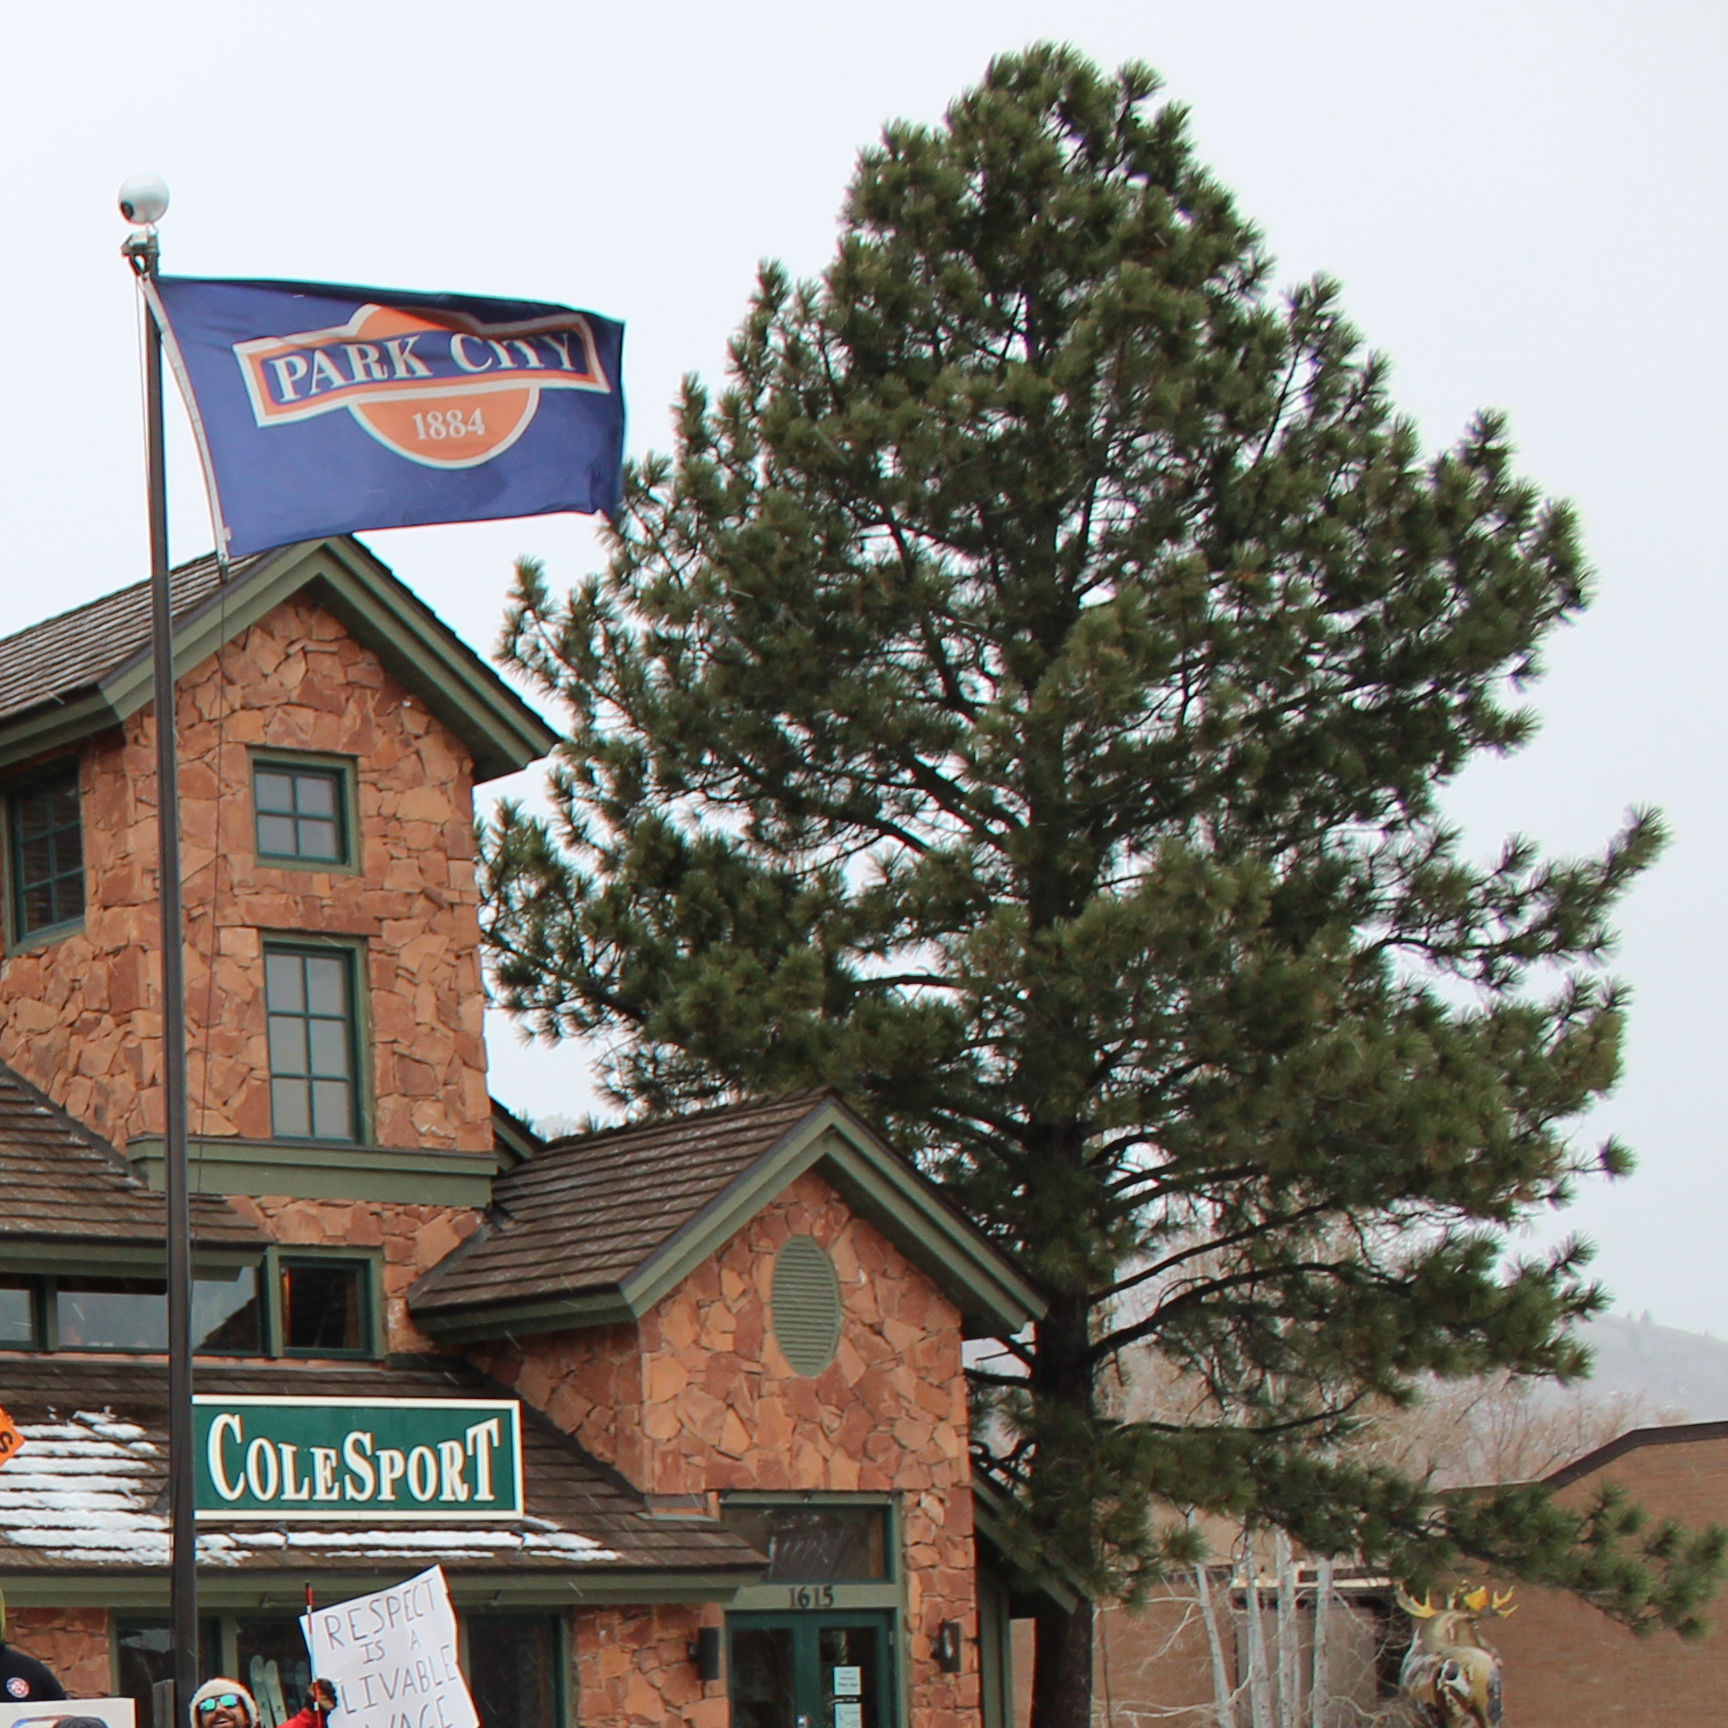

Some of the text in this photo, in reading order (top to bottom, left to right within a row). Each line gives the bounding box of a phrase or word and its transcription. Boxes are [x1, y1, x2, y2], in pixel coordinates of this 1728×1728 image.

[269, 332, 578, 402] PARK CITY
[412, 408, 486, 440] 1884
[324, 1577, 435, 1650] RESPECT
[789, 1586, 834, 1608] 1615
[360, 1629, 421, 1664] IS A
[341, 1645, 457, 1715] LIVABLE
